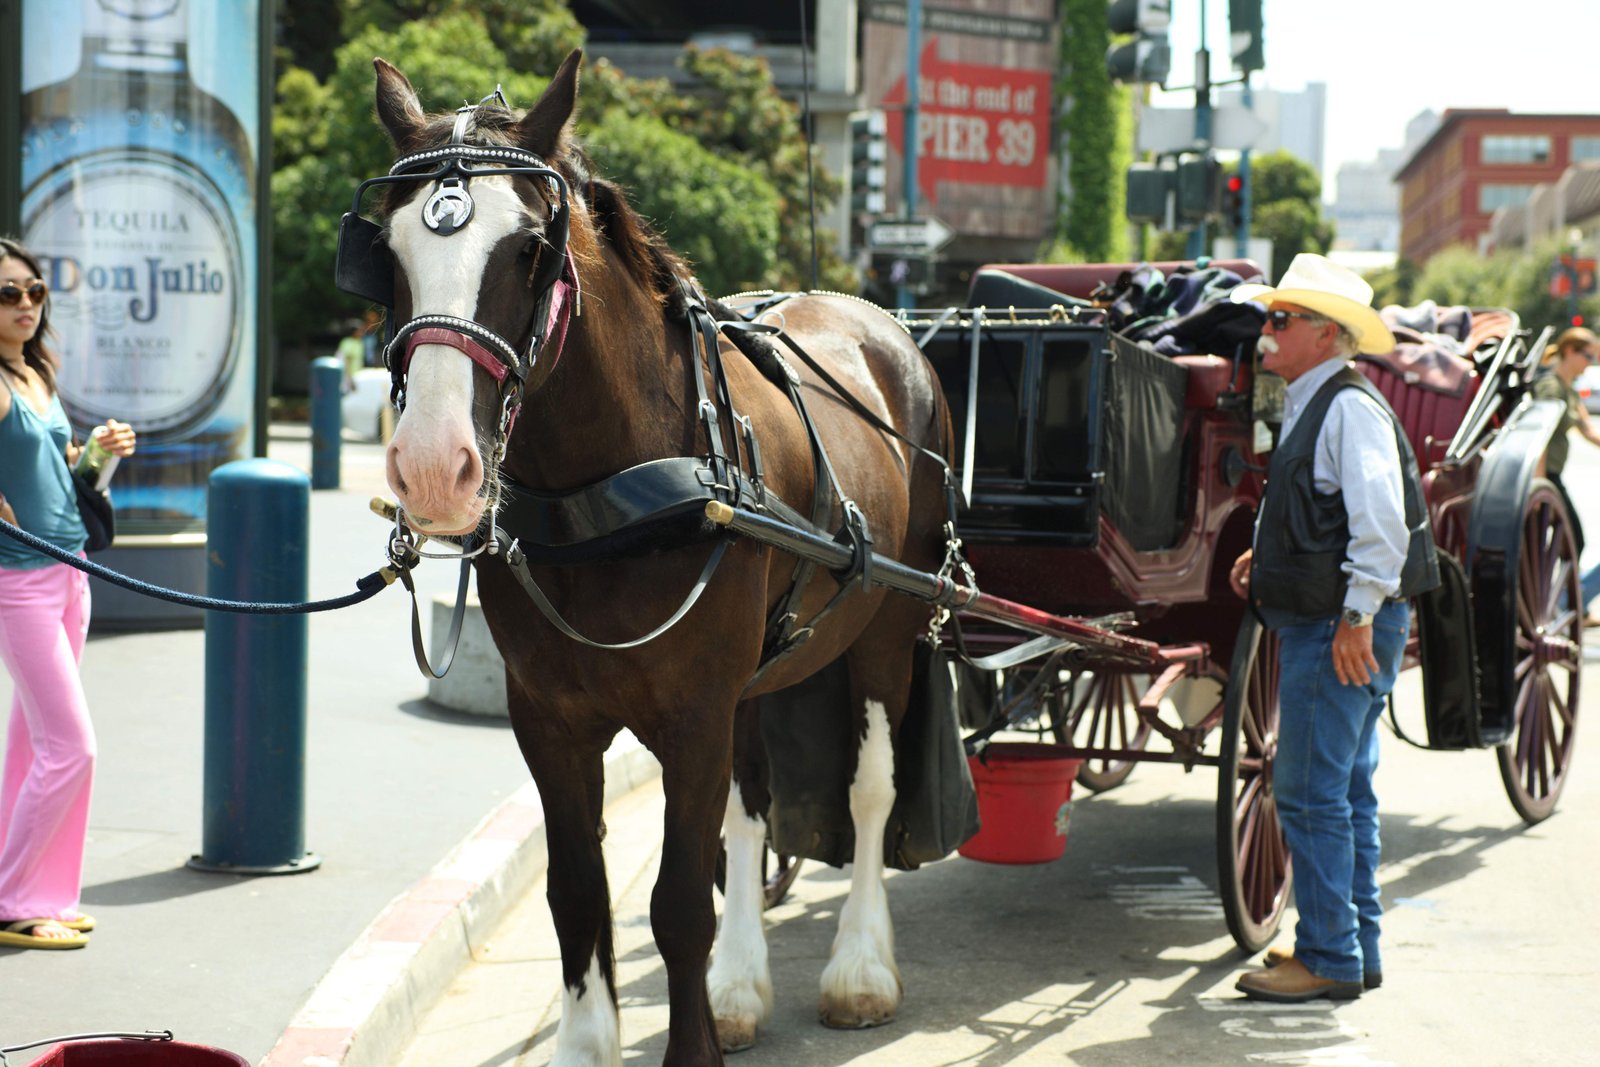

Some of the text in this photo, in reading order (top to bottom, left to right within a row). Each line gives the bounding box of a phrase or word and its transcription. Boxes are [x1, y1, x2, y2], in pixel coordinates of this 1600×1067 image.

[939, 79, 971, 109] the
[975, 85, 1011, 112] end
[1014, 84, 1036, 114] of
[917, 111, 1035, 166] PIER 39
[73, 209, 190, 235] TEQUILA
[40, 254, 223, 323] Don Julio
